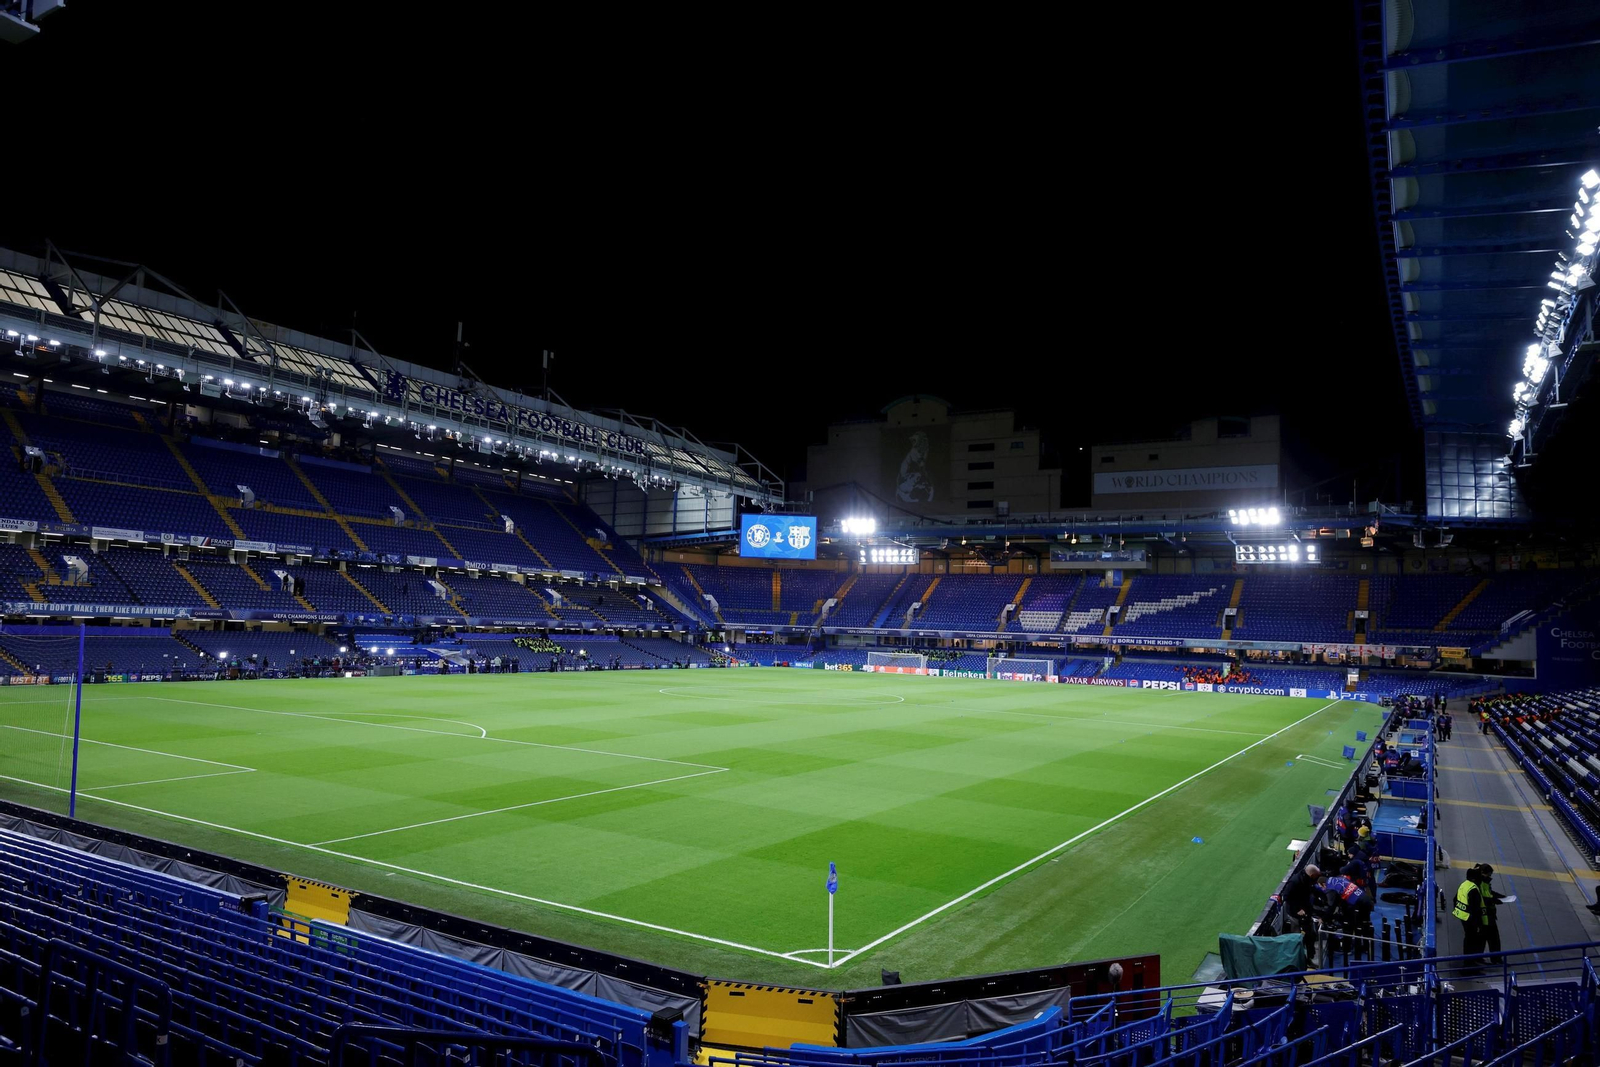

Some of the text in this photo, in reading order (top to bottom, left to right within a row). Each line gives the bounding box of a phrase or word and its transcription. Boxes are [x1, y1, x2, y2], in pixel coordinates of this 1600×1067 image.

[421, 385, 644, 454] CHELSEA FOOTBALL CLUB
[1112, 471, 1258, 488] WORLD CHAMPIONS
[30, 602, 175, 615] THEY DON'T MAKE THEM LIKE RAY ANYMORE
[1550, 628, 1595, 639] CHELSEA
[824, 662, 853, 672] bet365
[141, 674, 163, 682] PEPSI
[942, 669, 984, 680] Heineken
[1090, 678, 1124, 687] AIRWAYS
[1143, 680, 1180, 691] PEPSI
[1228, 686, 1285, 696] crypto.com
[1341, 692, 1368, 701] PS5
